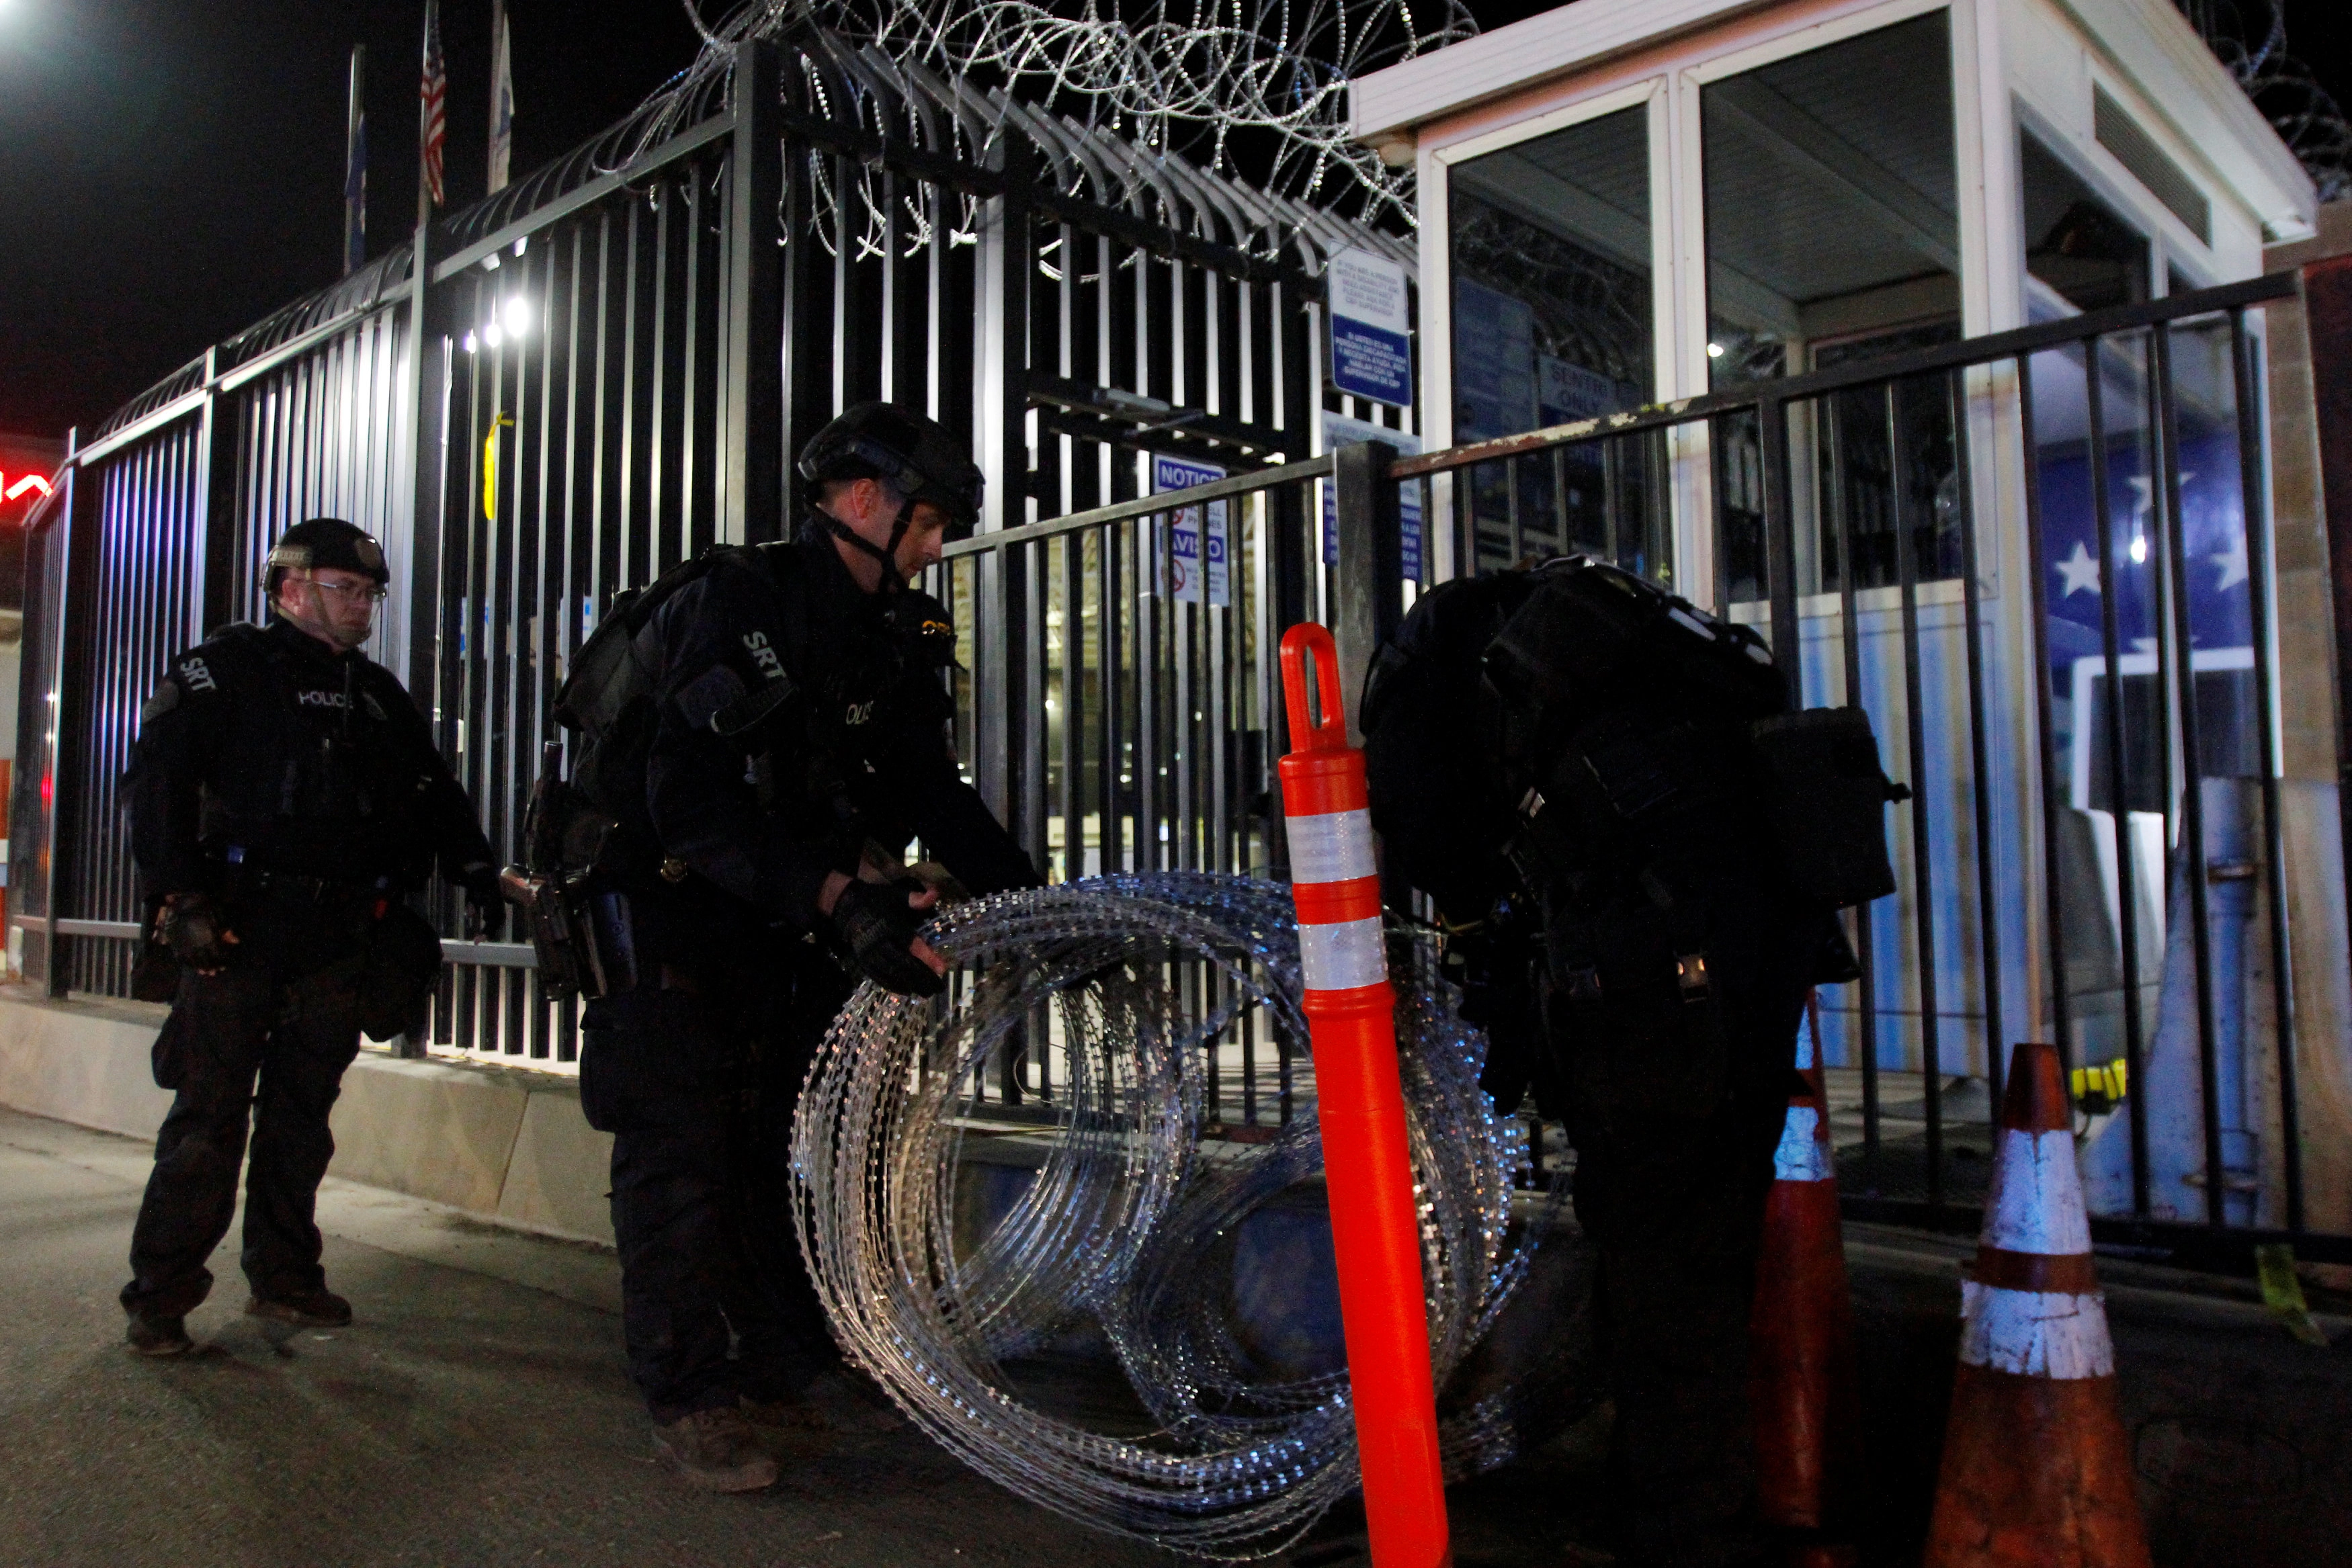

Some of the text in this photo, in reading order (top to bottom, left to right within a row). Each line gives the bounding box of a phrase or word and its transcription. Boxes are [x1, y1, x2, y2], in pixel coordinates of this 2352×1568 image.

[1172, 531, 1222, 558] VIO
[743, 631, 787, 679] SRT
[180, 657, 217, 691] SRT
